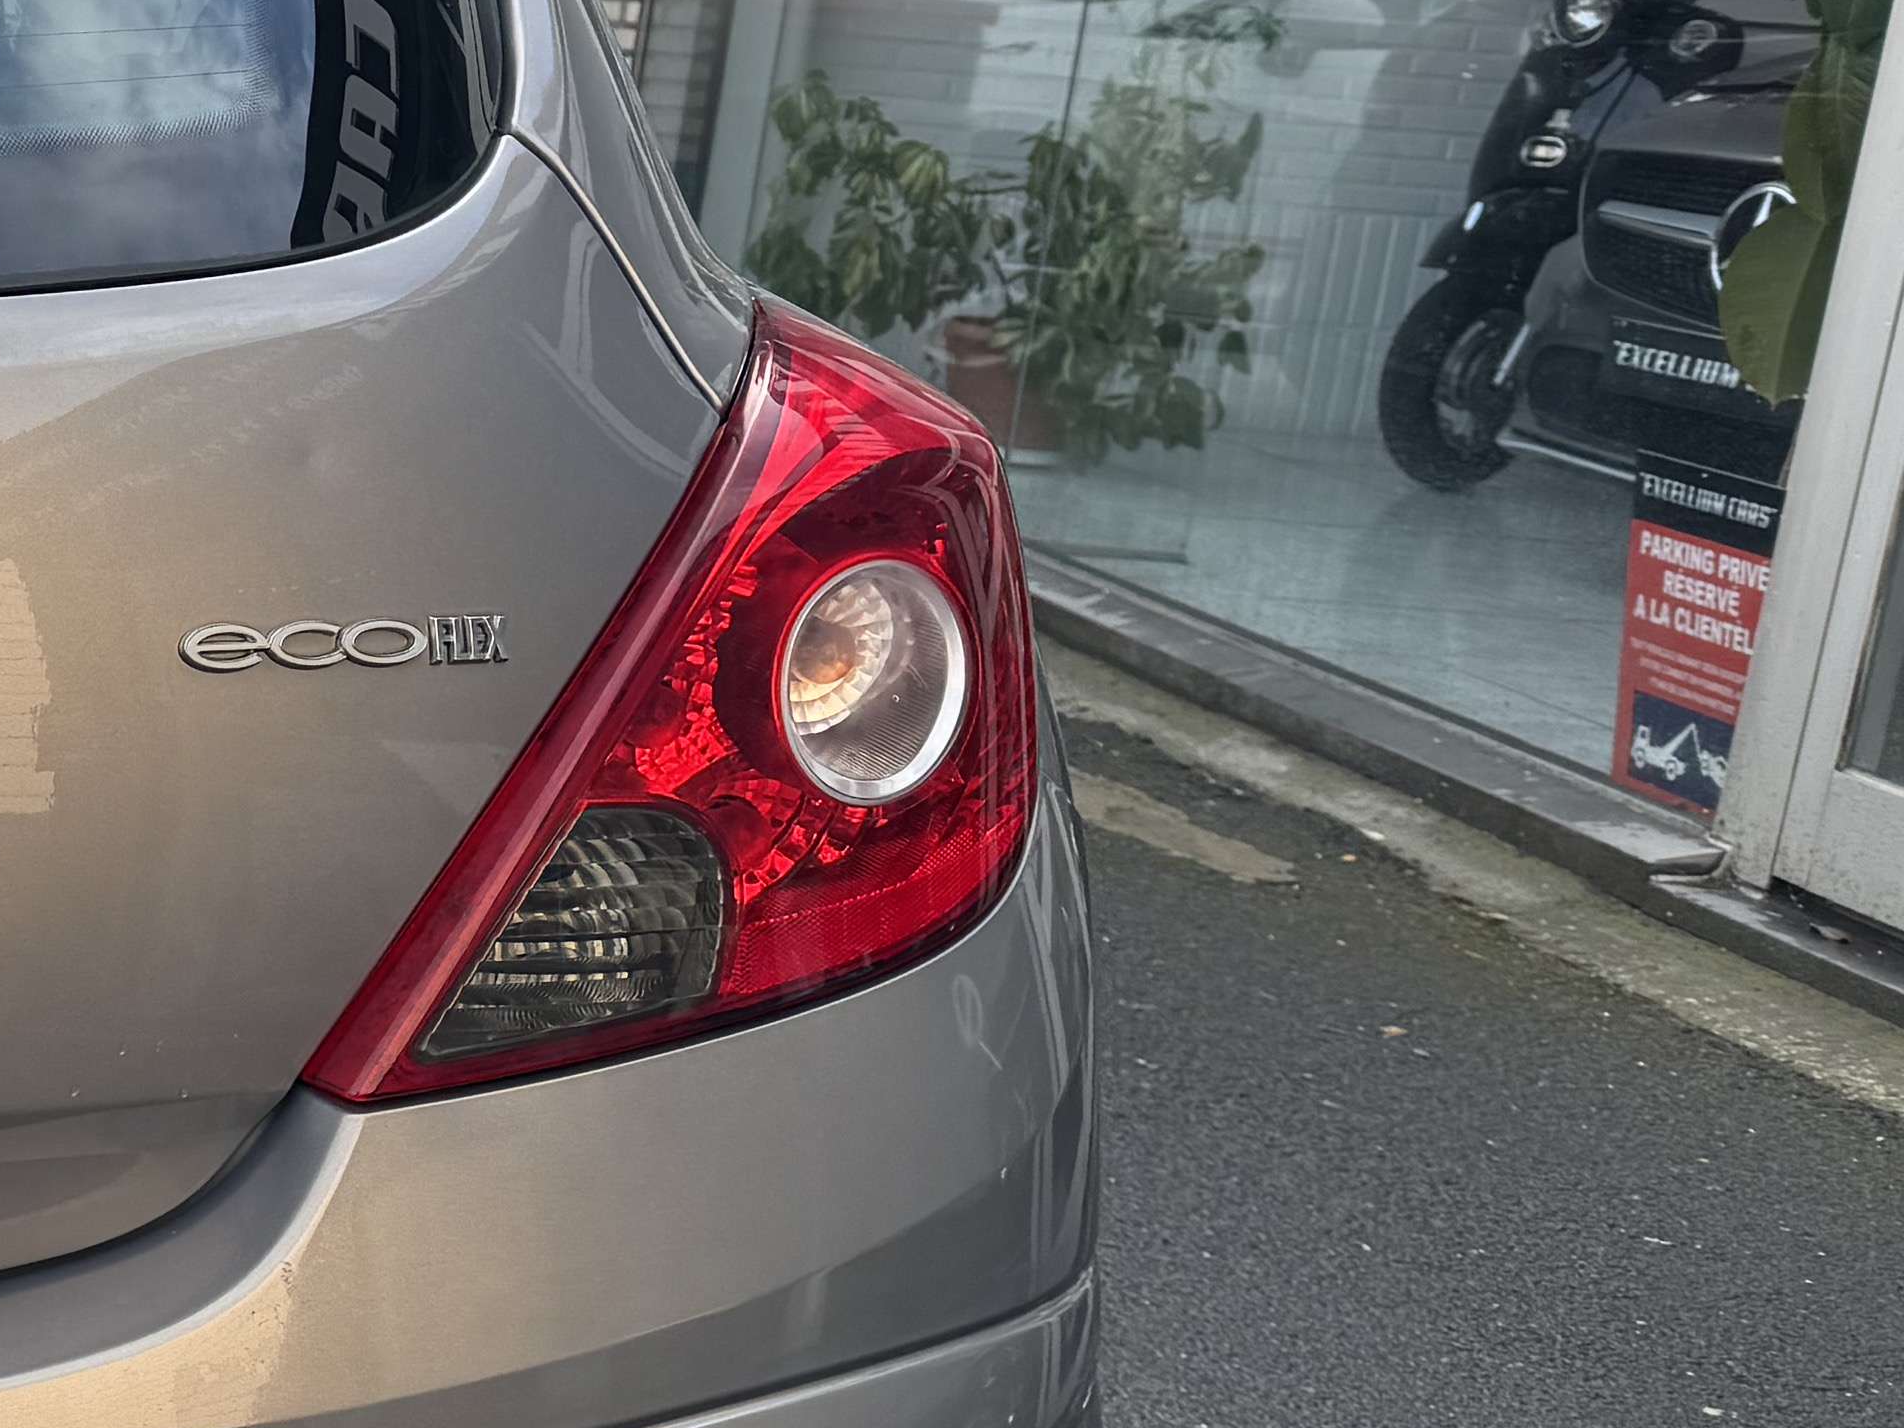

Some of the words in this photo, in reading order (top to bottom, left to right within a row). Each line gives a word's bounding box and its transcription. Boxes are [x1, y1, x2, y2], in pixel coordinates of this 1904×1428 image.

[1639, 530, 1714, 575] PARKING
[1650, 600, 1670, 627] LA
[1674, 606, 1754, 656] CLIENTÈL
